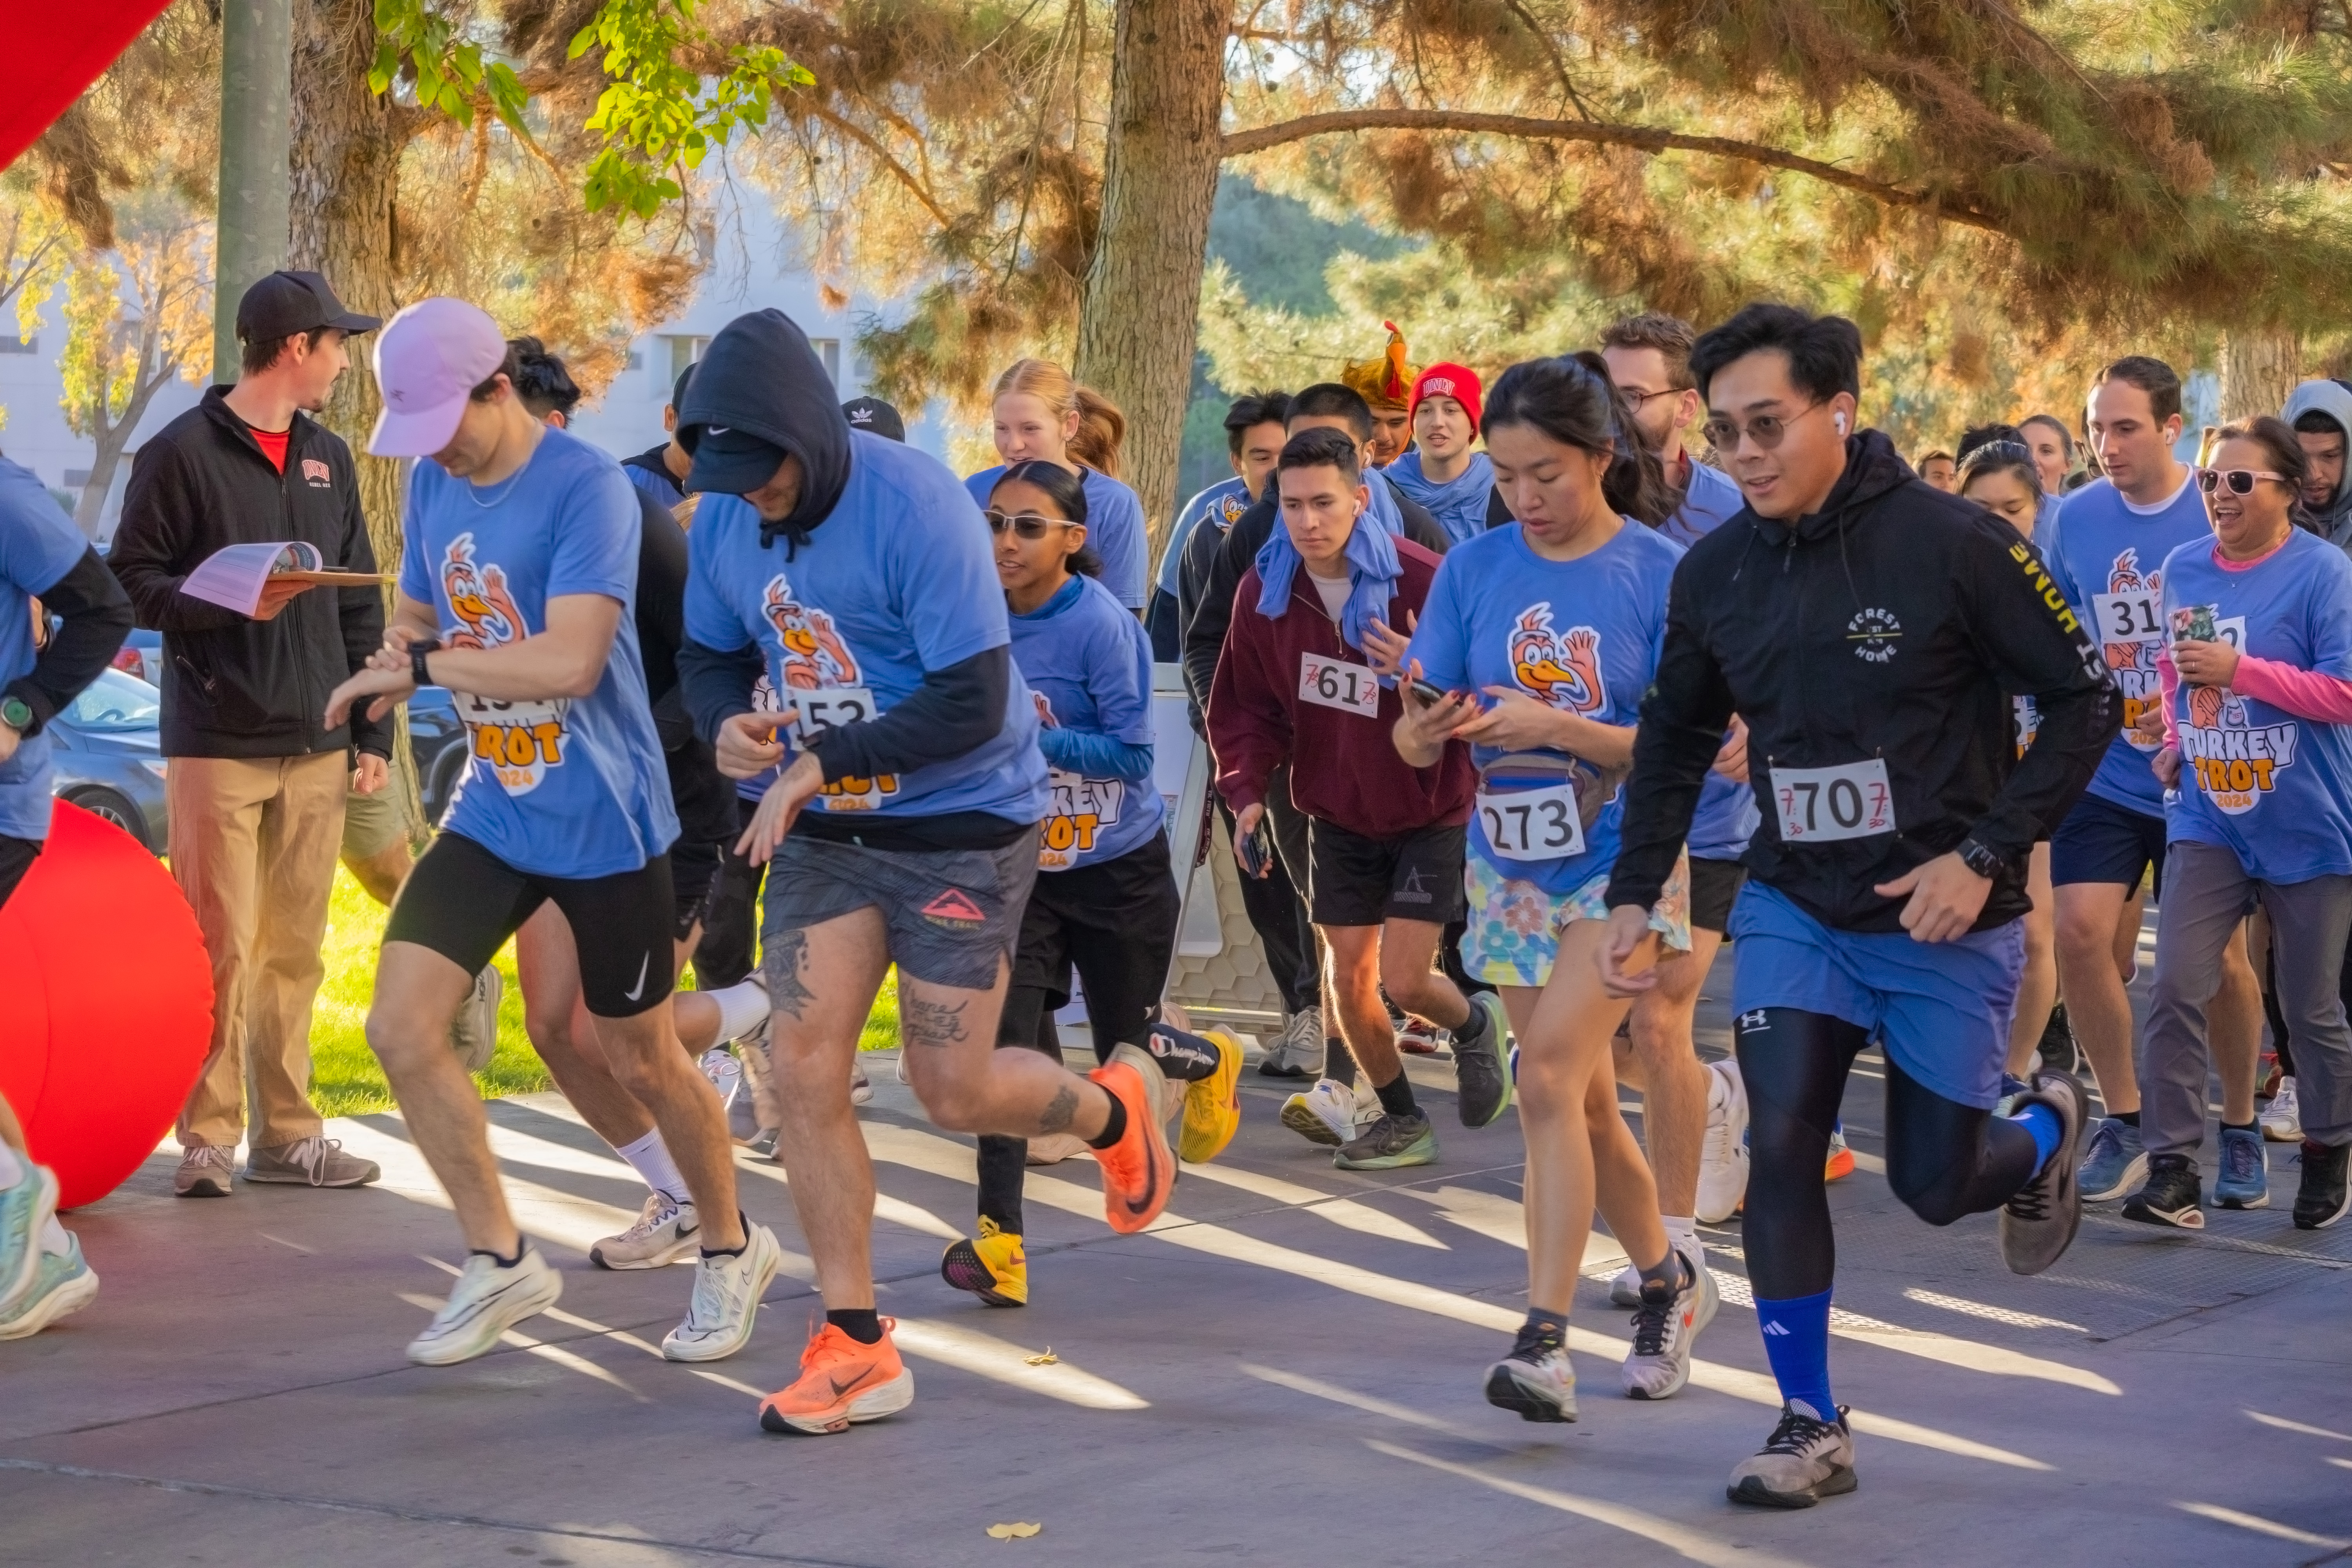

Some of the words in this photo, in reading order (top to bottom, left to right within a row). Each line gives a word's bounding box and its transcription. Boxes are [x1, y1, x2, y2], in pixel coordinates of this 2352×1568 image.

[1423, 378, 1455, 397] UNLV
[302, 459, 330, 482] UNLV
[1848, 608, 1901, 632] FOREST
[2111, 599, 2161, 636] 31
[1855, 645, 1897, 663] HOME
[1318, 666, 1360, 706] 61
[472, 720, 564, 768] ROT
[2130, 731, 2157, 745] 202
[2176, 721, 2299, 767] TURKEY
[495, 769, 534, 787] 024
[2195, 757, 2275, 793] TROT
[1049, 778, 1123, 825] KEY
[1793, 778, 1864, 831] 70
[2216, 794, 2252, 808] 2024
[1040, 814, 1098, 852] OT
[1483, 799, 1573, 851] 273
